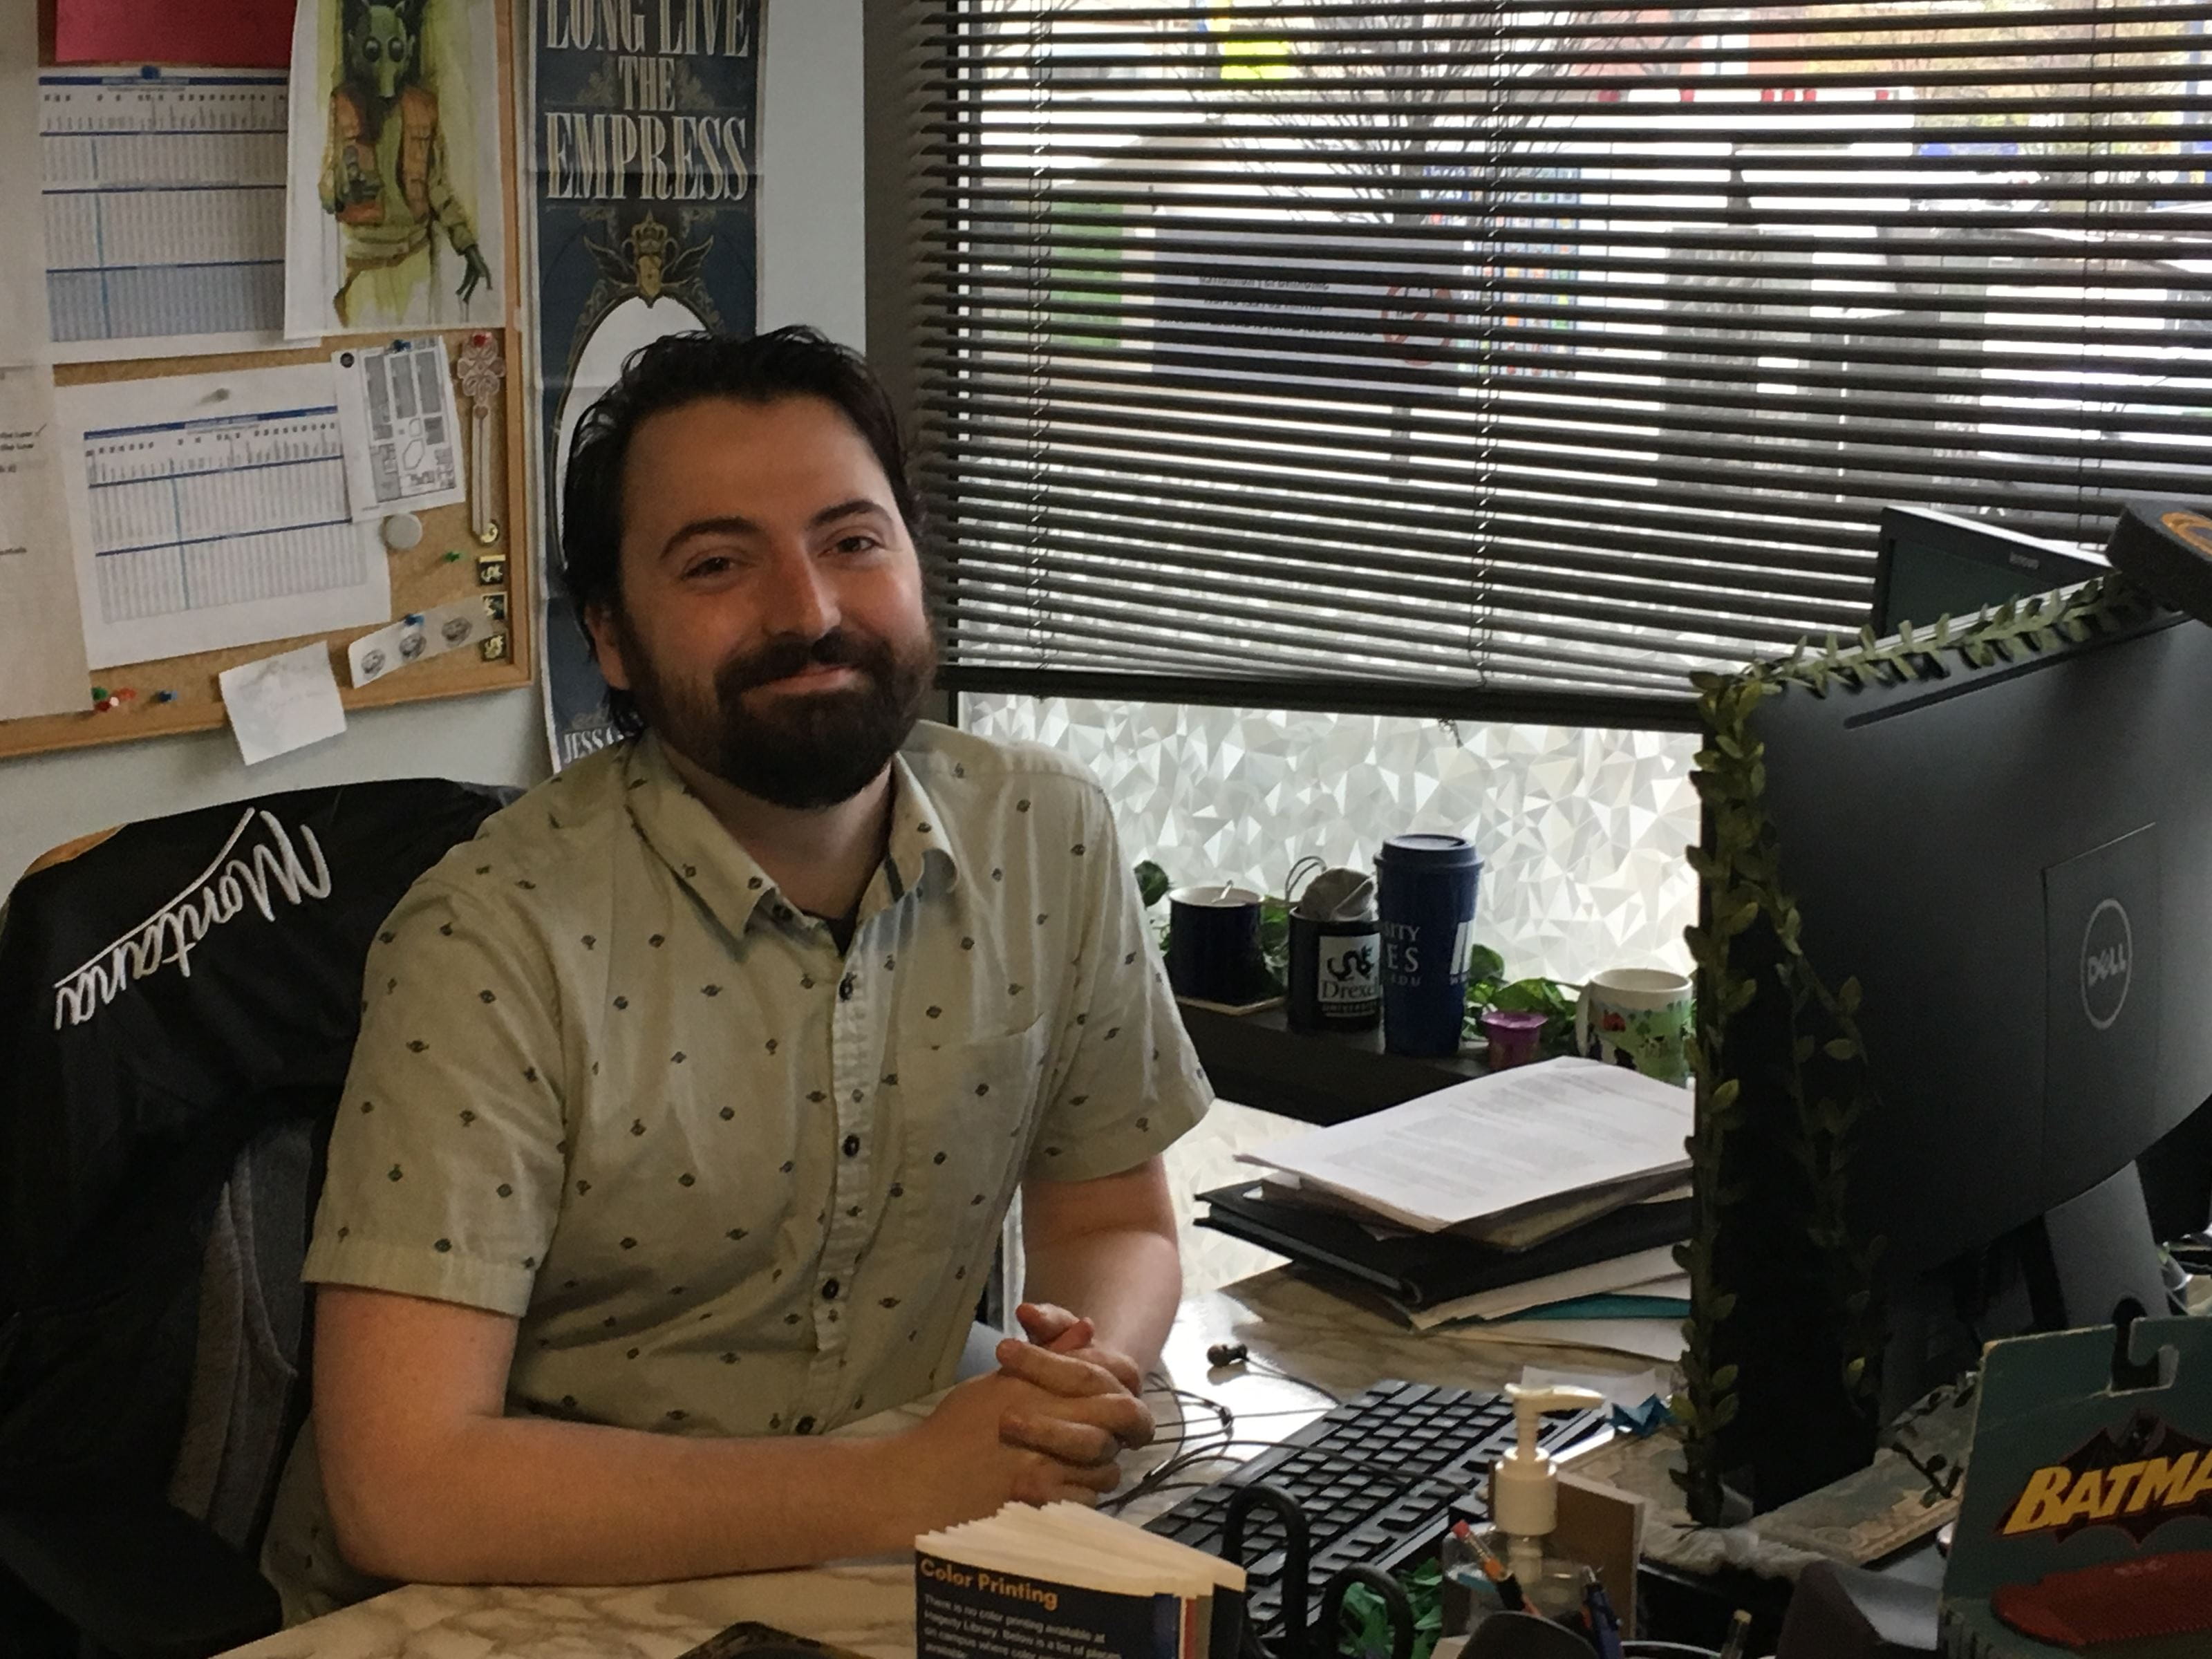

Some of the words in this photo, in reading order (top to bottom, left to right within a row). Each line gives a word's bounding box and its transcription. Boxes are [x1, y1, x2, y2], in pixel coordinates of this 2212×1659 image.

[546, 0, 645, 53] LONG
[659, 0, 750, 57] LIVE
[619, 55, 675, 112] THE
[545, 111, 748, 200] EMPRESS
[54, 807, 332, 1030] Montana
[1321, 976, 1379, 999] Drexel
[2088, 943, 2126, 987] DELL
[2003, 1448, 2212, 1535] BATMA
[920, 1558, 973, 1588] Color
[978, 1573, 1058, 1611] Printing
[924, 1593, 951, 1610] There
[964, 1606, 978, 1618] no
[979, 1609, 1004, 1622] color
[1006, 1615, 1044, 1634] printing
[1045, 1624, 1092, 1642] available
